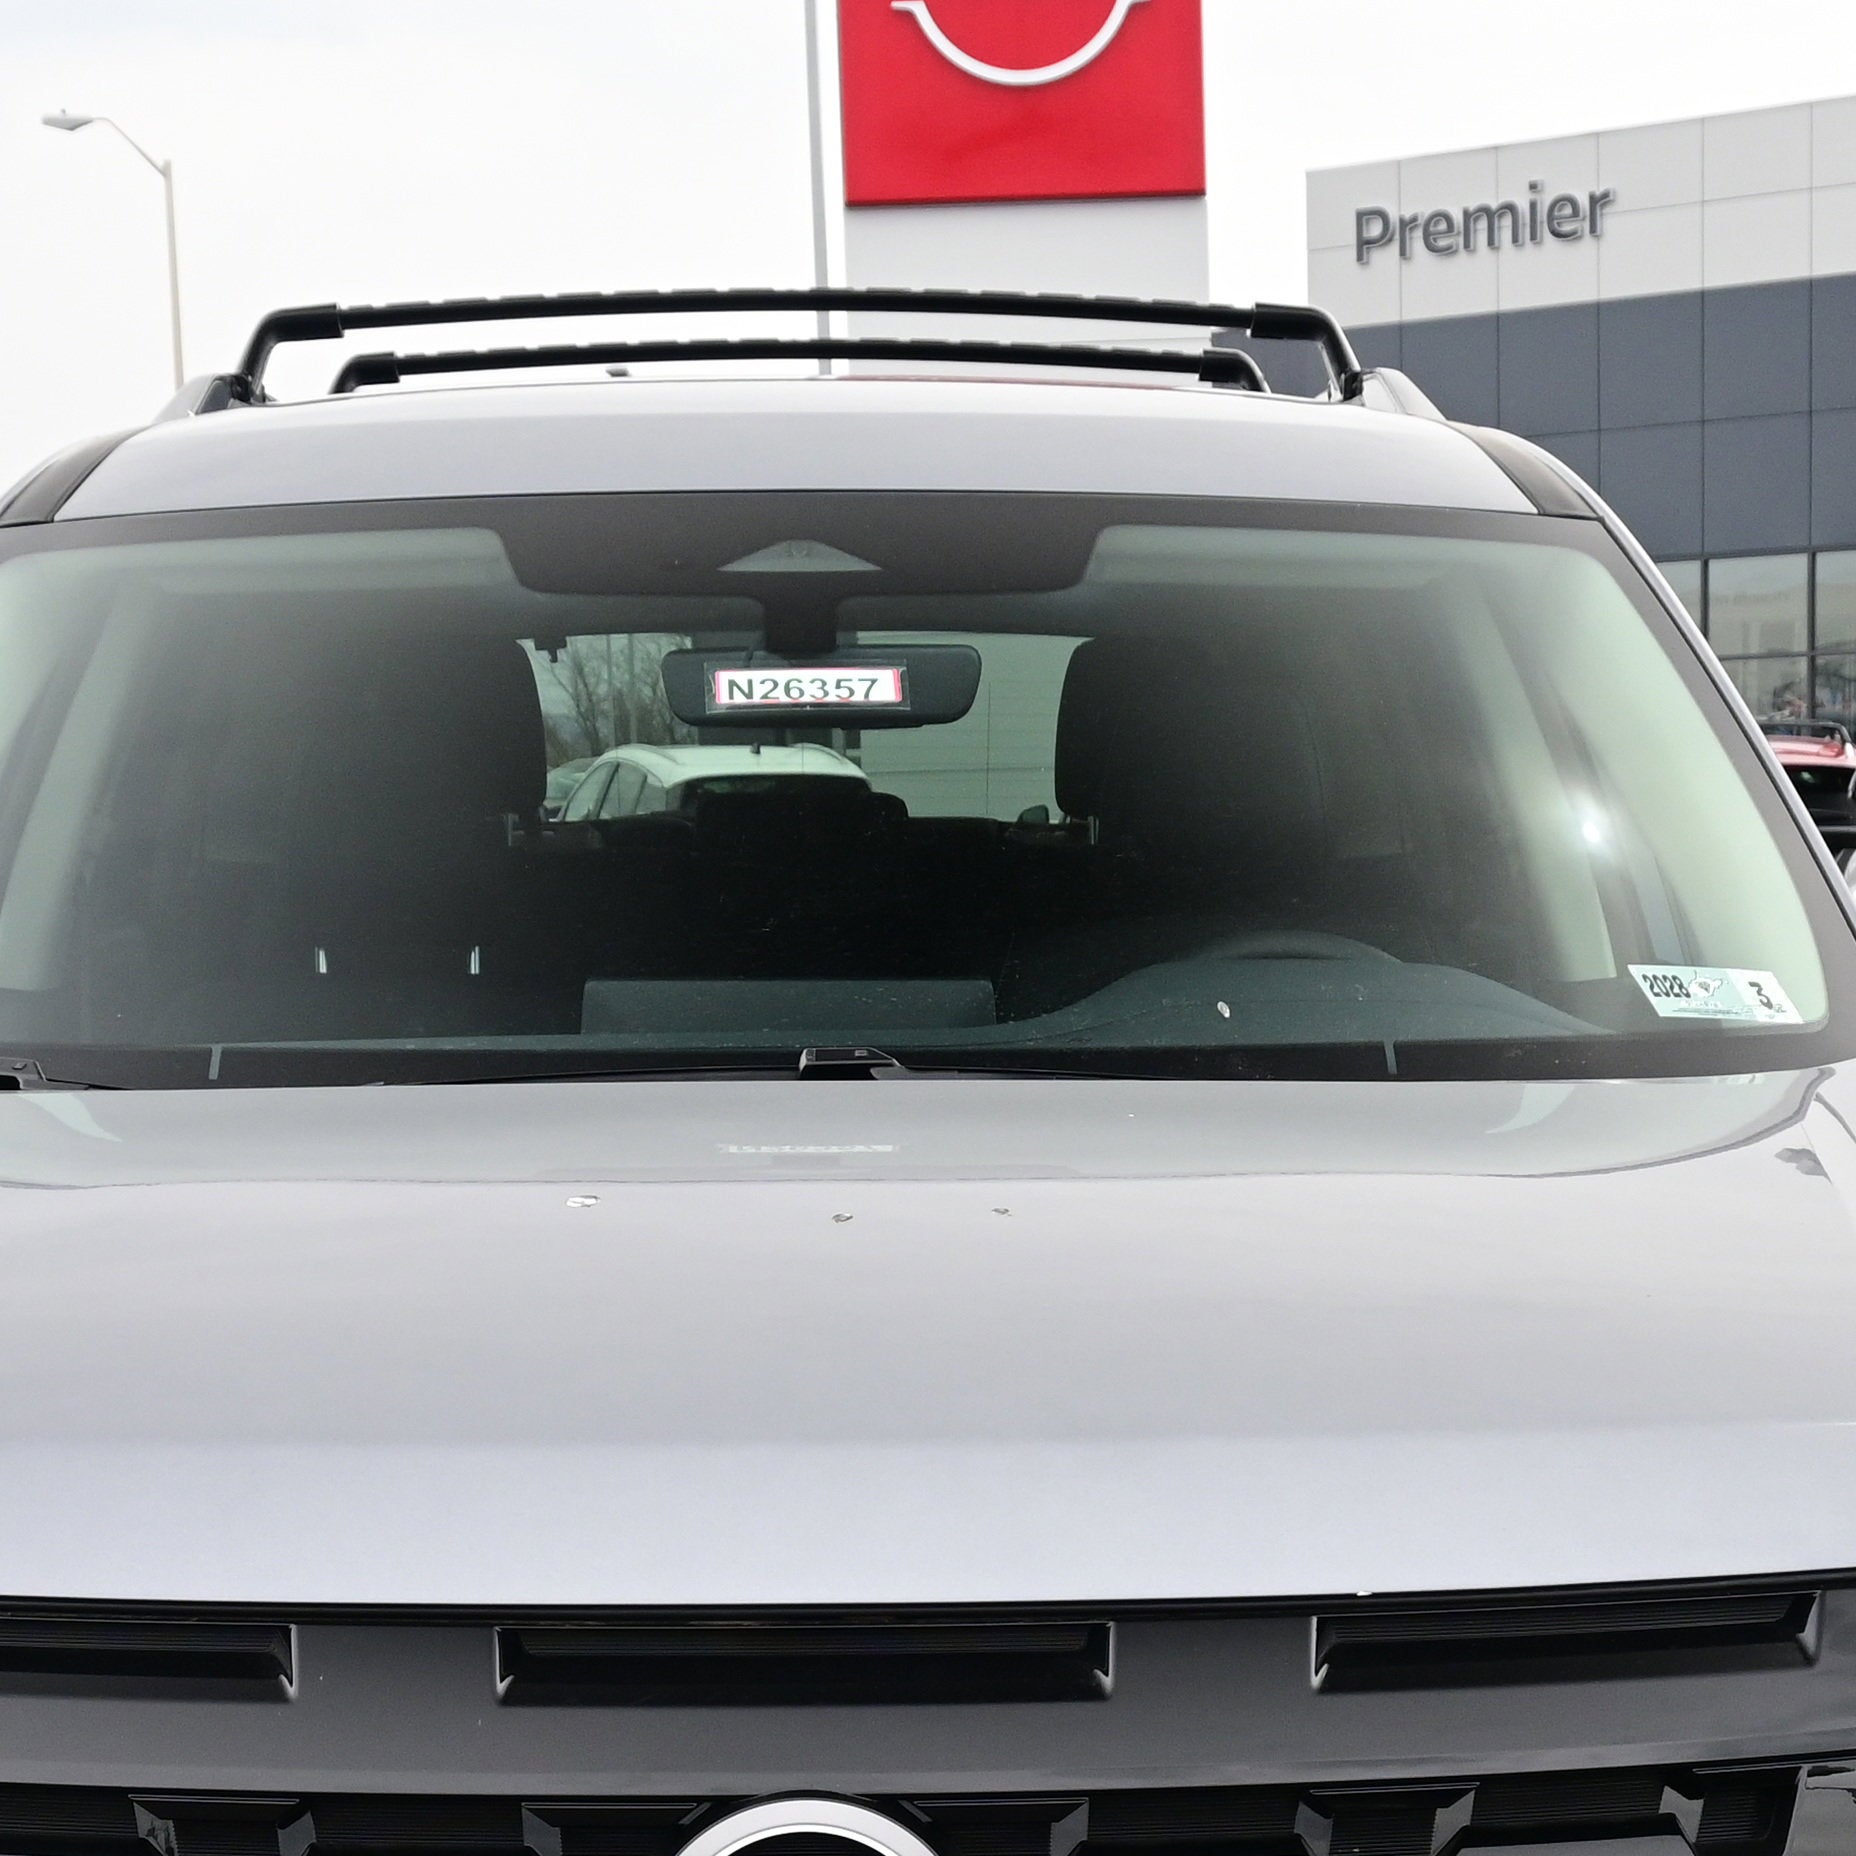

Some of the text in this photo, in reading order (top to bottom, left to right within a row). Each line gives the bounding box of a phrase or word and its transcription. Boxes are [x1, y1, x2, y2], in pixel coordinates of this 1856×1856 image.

[1355, 179, 1615, 264] Premier
[727, 678, 879, 701] N26357
[1642, 974, 1691, 998] 2028
[1748, 981, 1774, 1010] 3
